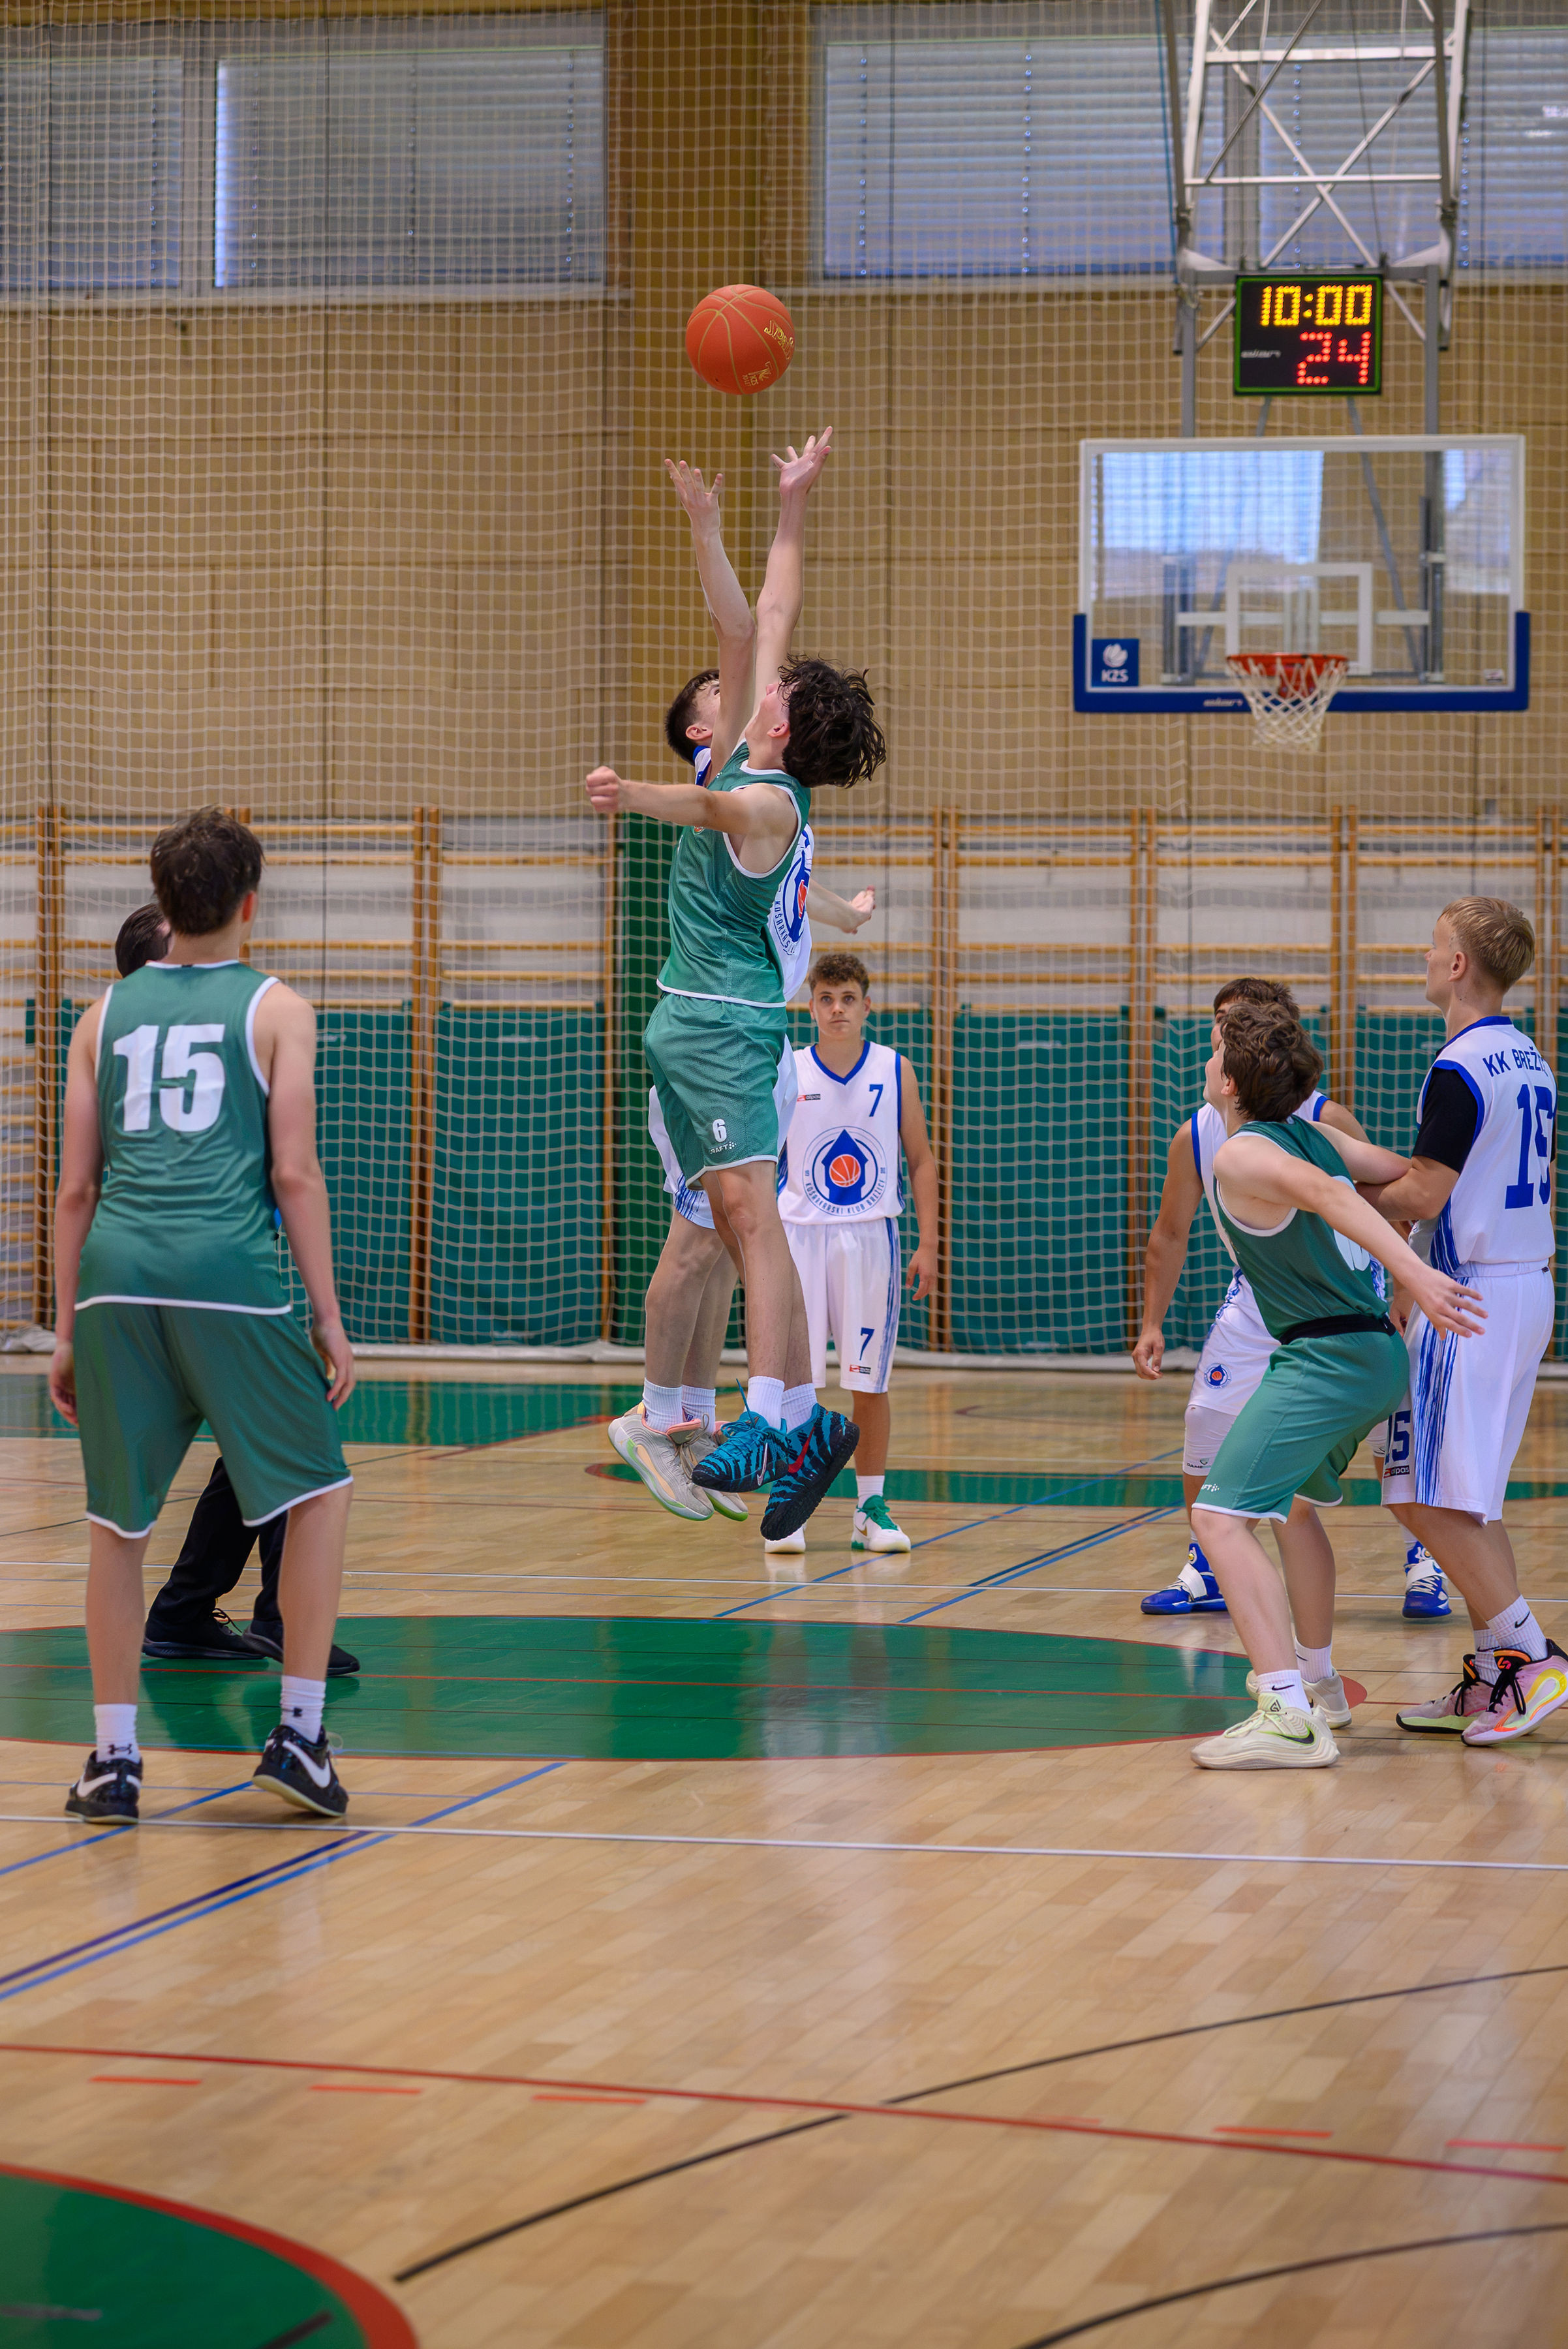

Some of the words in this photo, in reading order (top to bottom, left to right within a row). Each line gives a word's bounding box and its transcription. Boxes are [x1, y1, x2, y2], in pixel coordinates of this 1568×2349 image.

[1260, 284, 1373, 326] 10:00
[1296, 331, 1372, 384] 24
[1101, 669, 1129, 683] KZS
[113, 1023, 226, 1132] 15
[1483, 1051, 1511, 1077] KK
[869, 1084, 884, 1117] 7
[713, 1118, 728, 1143] 6
[710, 1144, 728, 1154] RAFT
[847, 1203, 865, 1214] KLUB
[859, 1327, 875, 1360] 7
